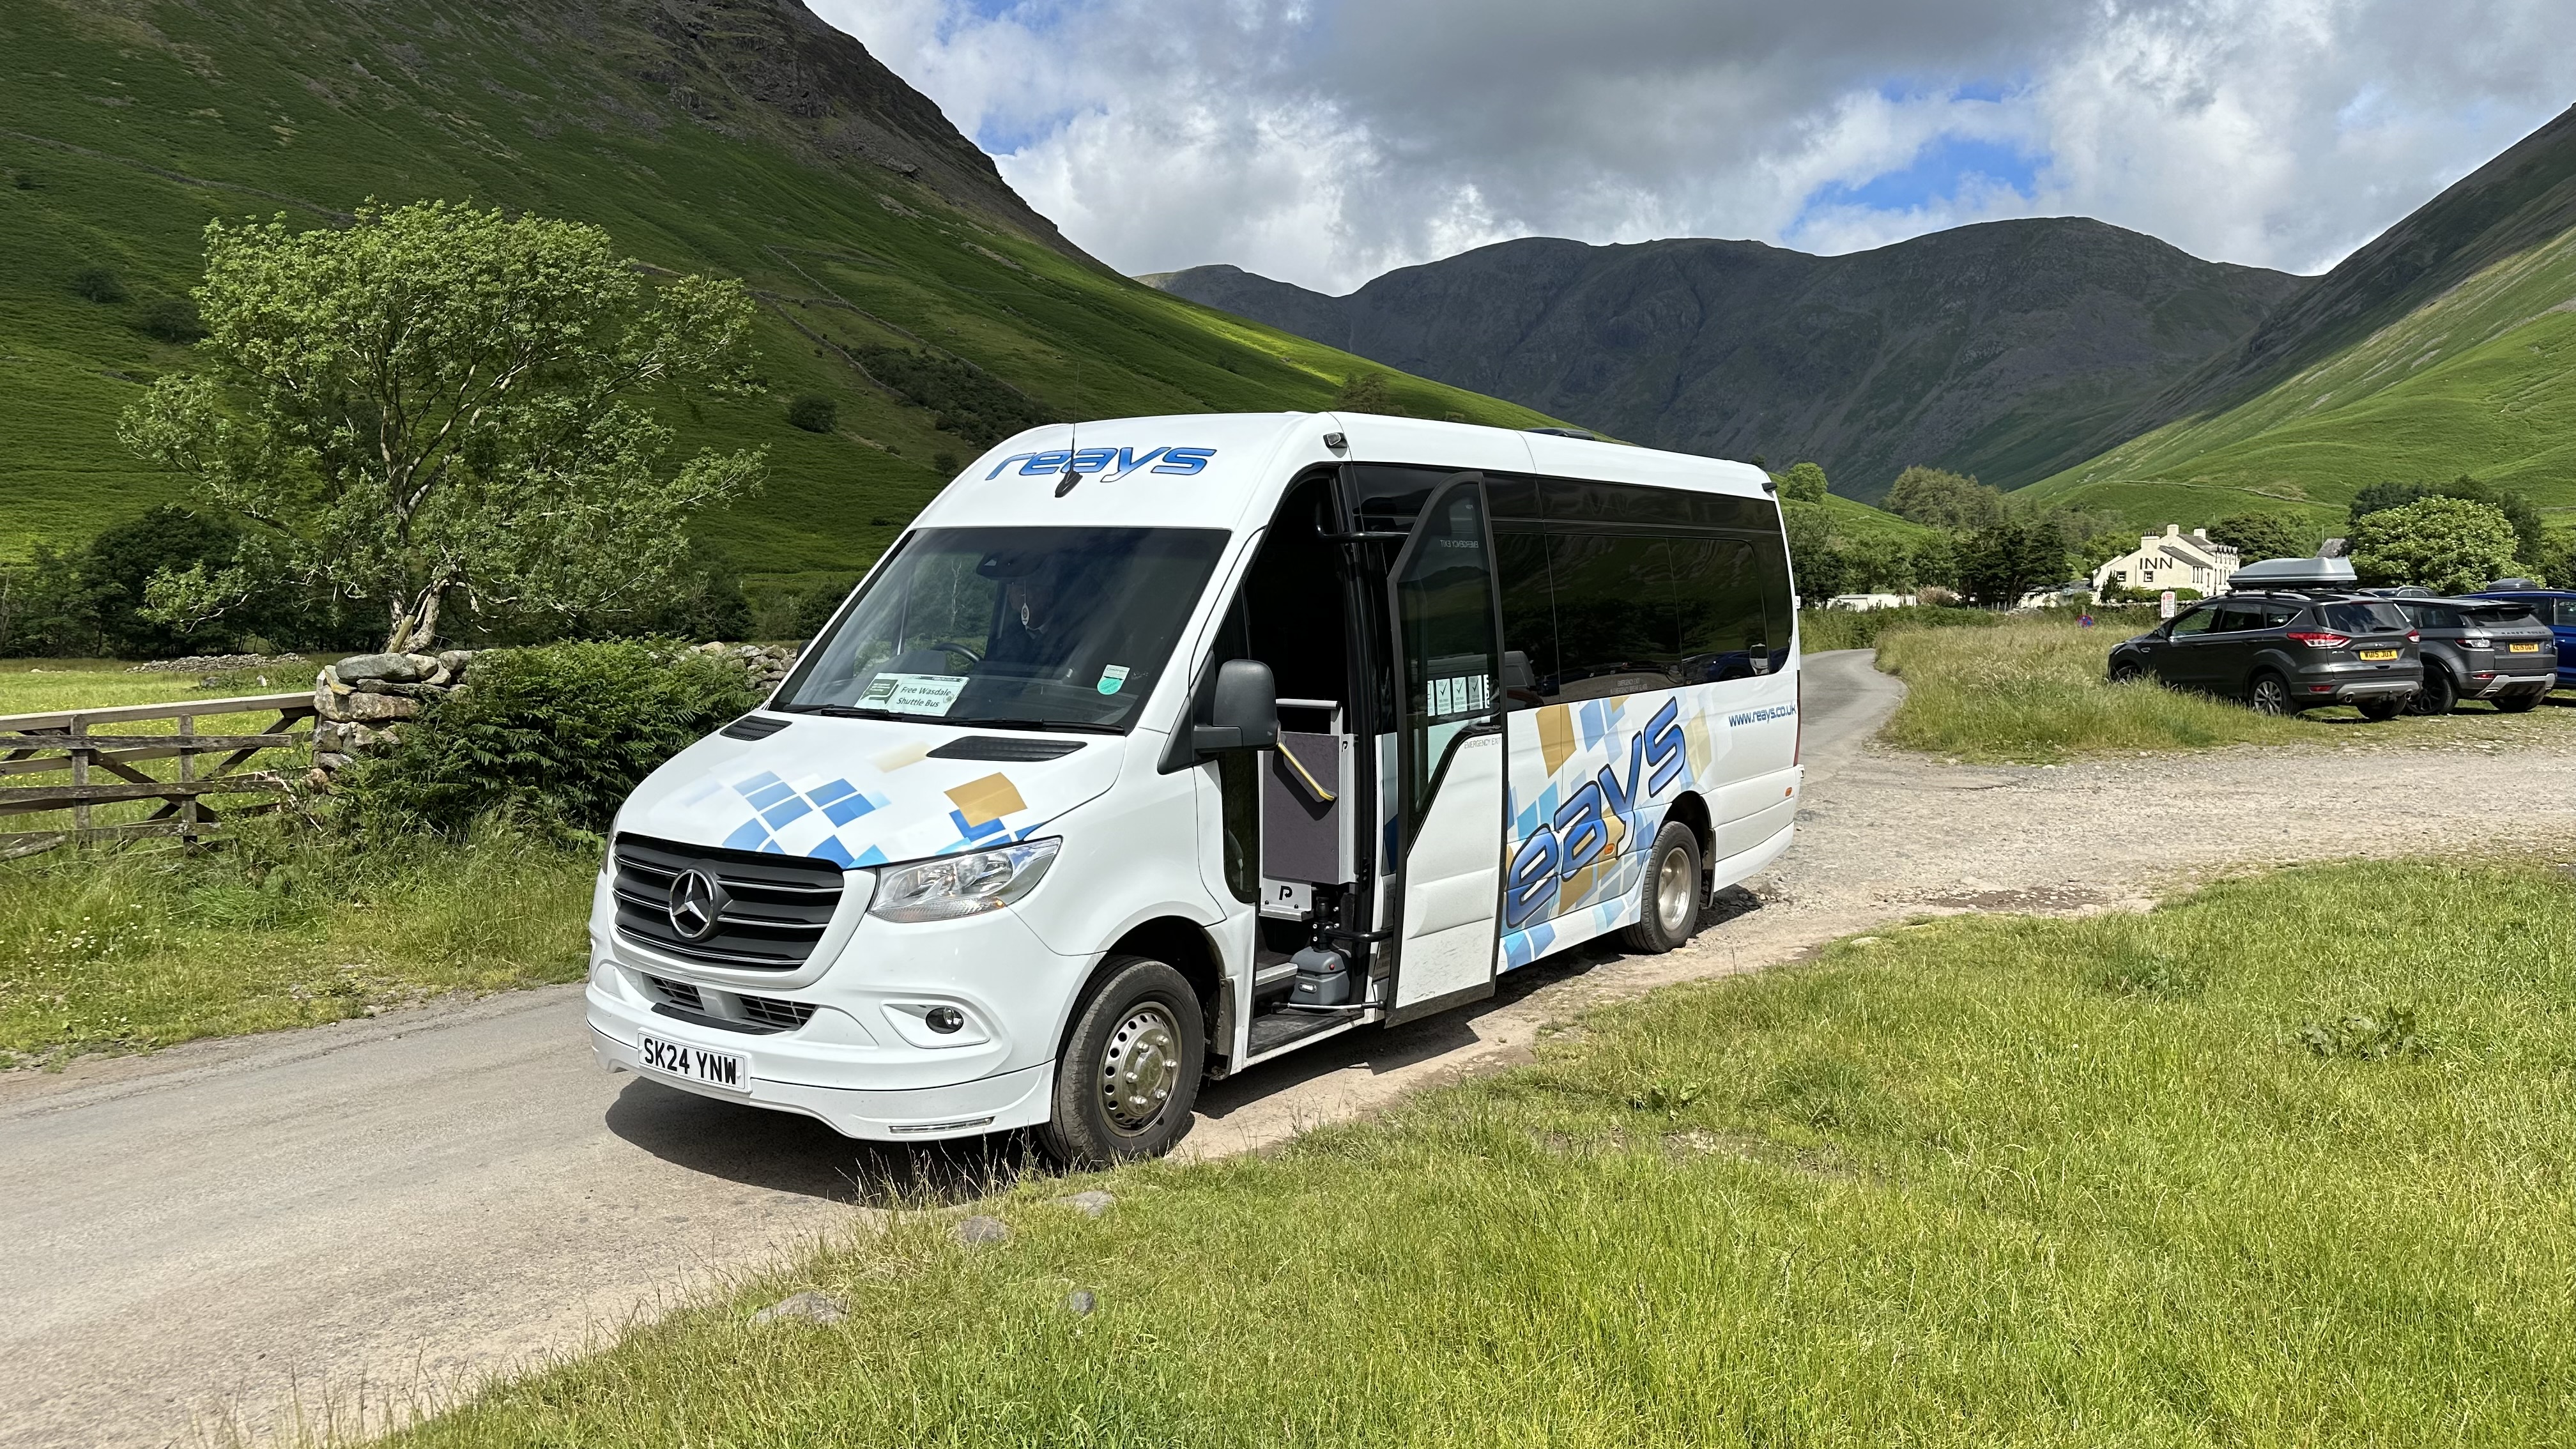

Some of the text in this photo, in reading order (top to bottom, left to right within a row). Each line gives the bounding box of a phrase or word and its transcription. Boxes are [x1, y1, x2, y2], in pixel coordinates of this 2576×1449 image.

[985, 447, 1217, 482] reays
[2140, 557, 2172, 569] INN
[919, 687, 952, 696] Wasdale
[896, 697, 940, 707] Shuttle Bus
[1728, 700, 1797, 727] www.reays.co.uk
[1464, 739, 1491, 749] EMERGENCY
[1506, 696, 1685, 928] eays
[644, 1038, 736, 1085] SK24 YNW
